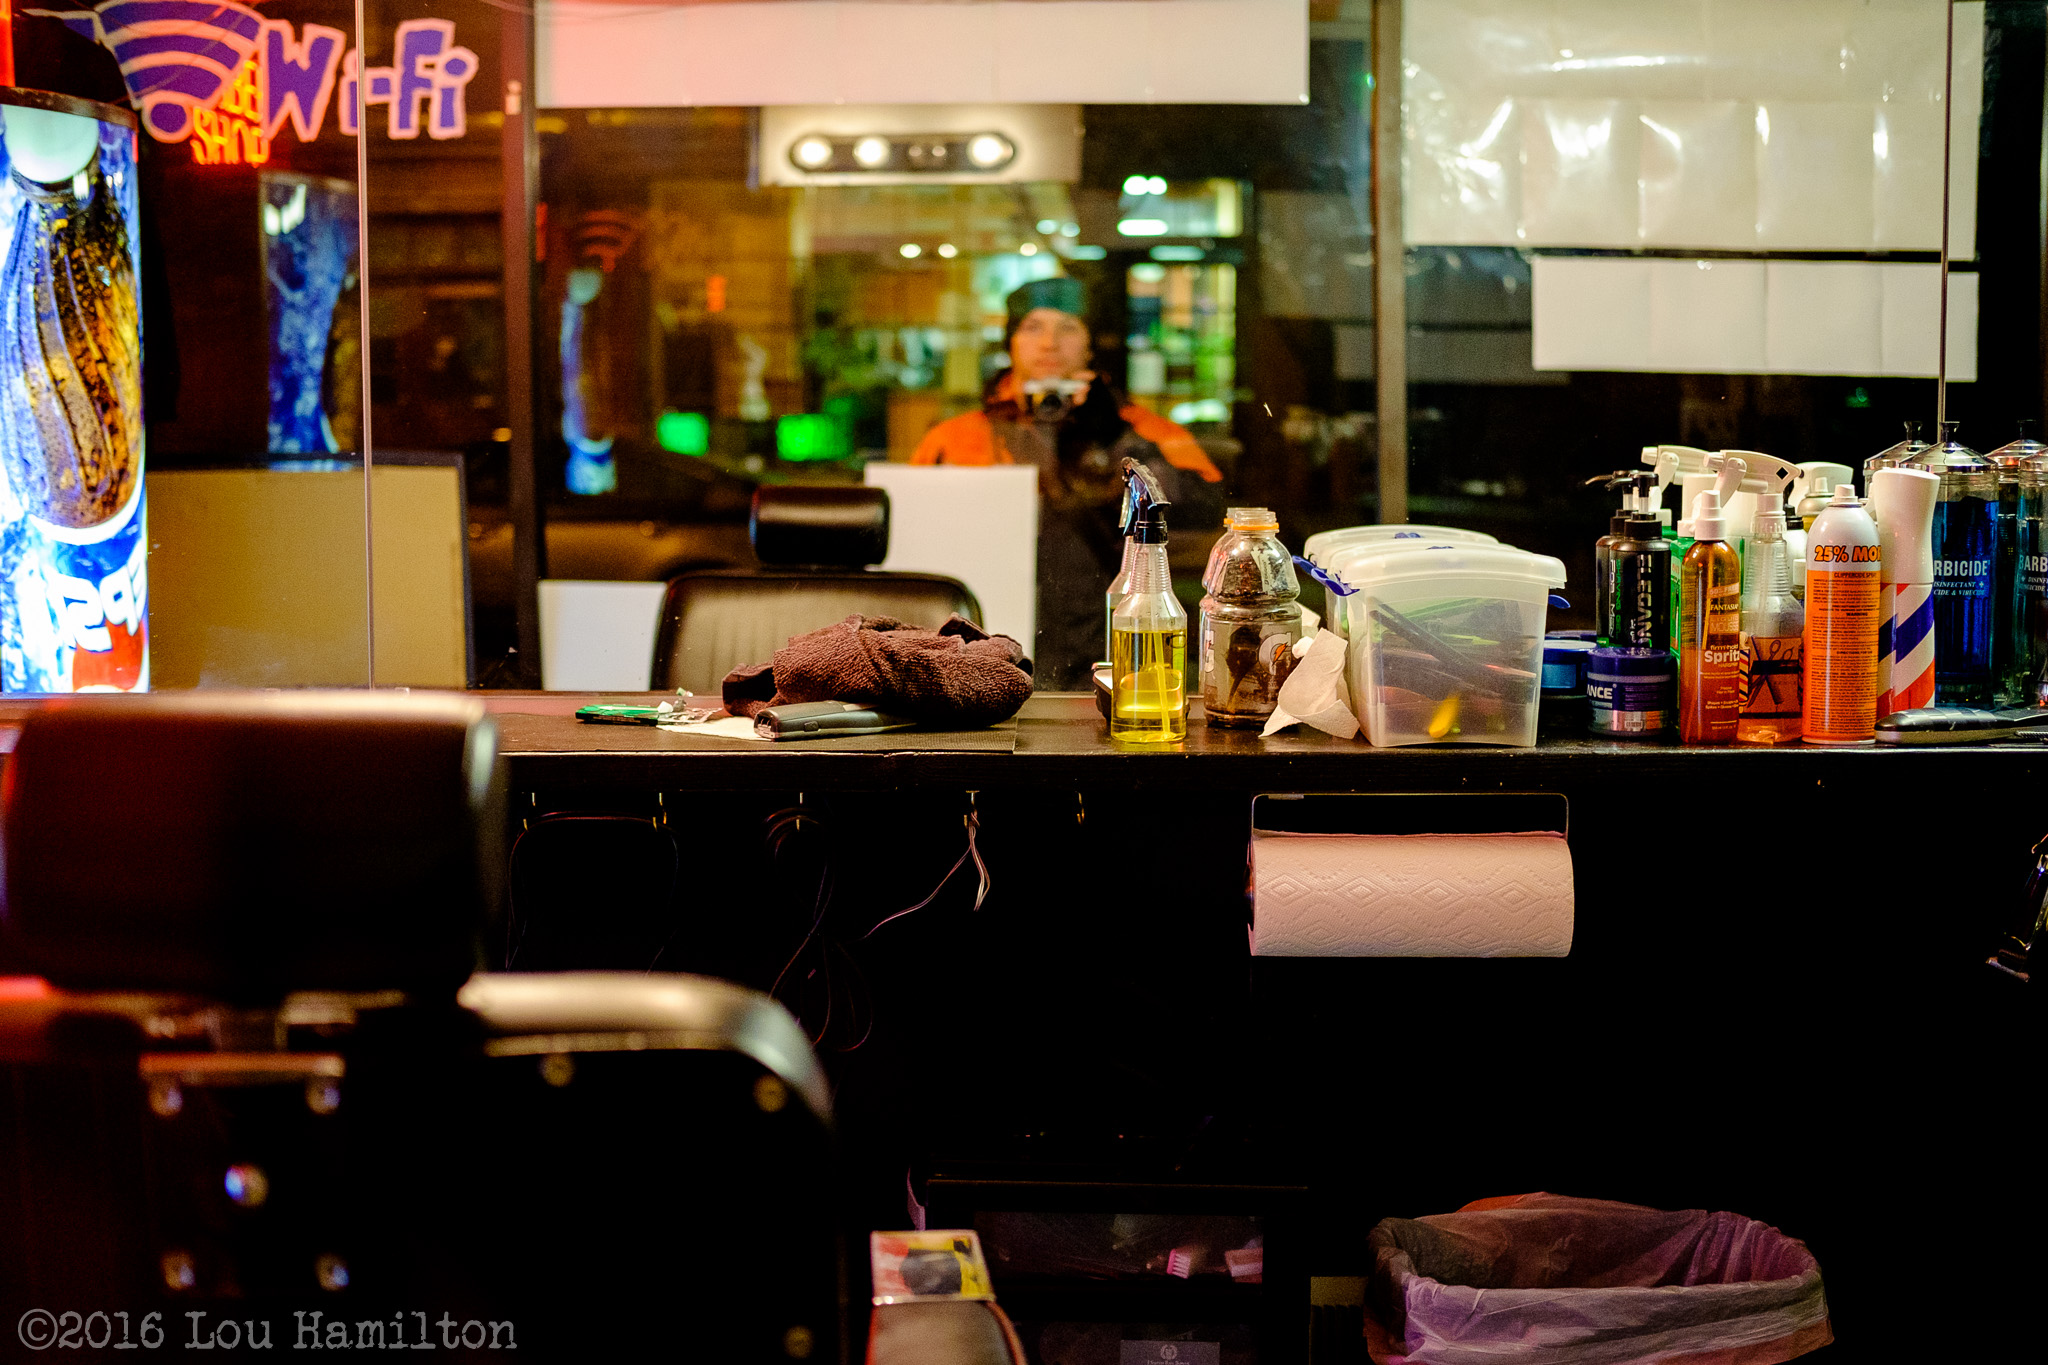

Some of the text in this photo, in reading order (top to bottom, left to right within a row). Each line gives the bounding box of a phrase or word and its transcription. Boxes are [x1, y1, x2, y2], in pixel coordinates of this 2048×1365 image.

[261, 18, 479, 142] Wi-Fi
[1814, 544, 1850, 563] 25%
[1933, 560, 1988, 576] RBICIDE
[2018, 554, 2048, 573] BARB
[1636, 553, 1653, 648] ELEGANC
